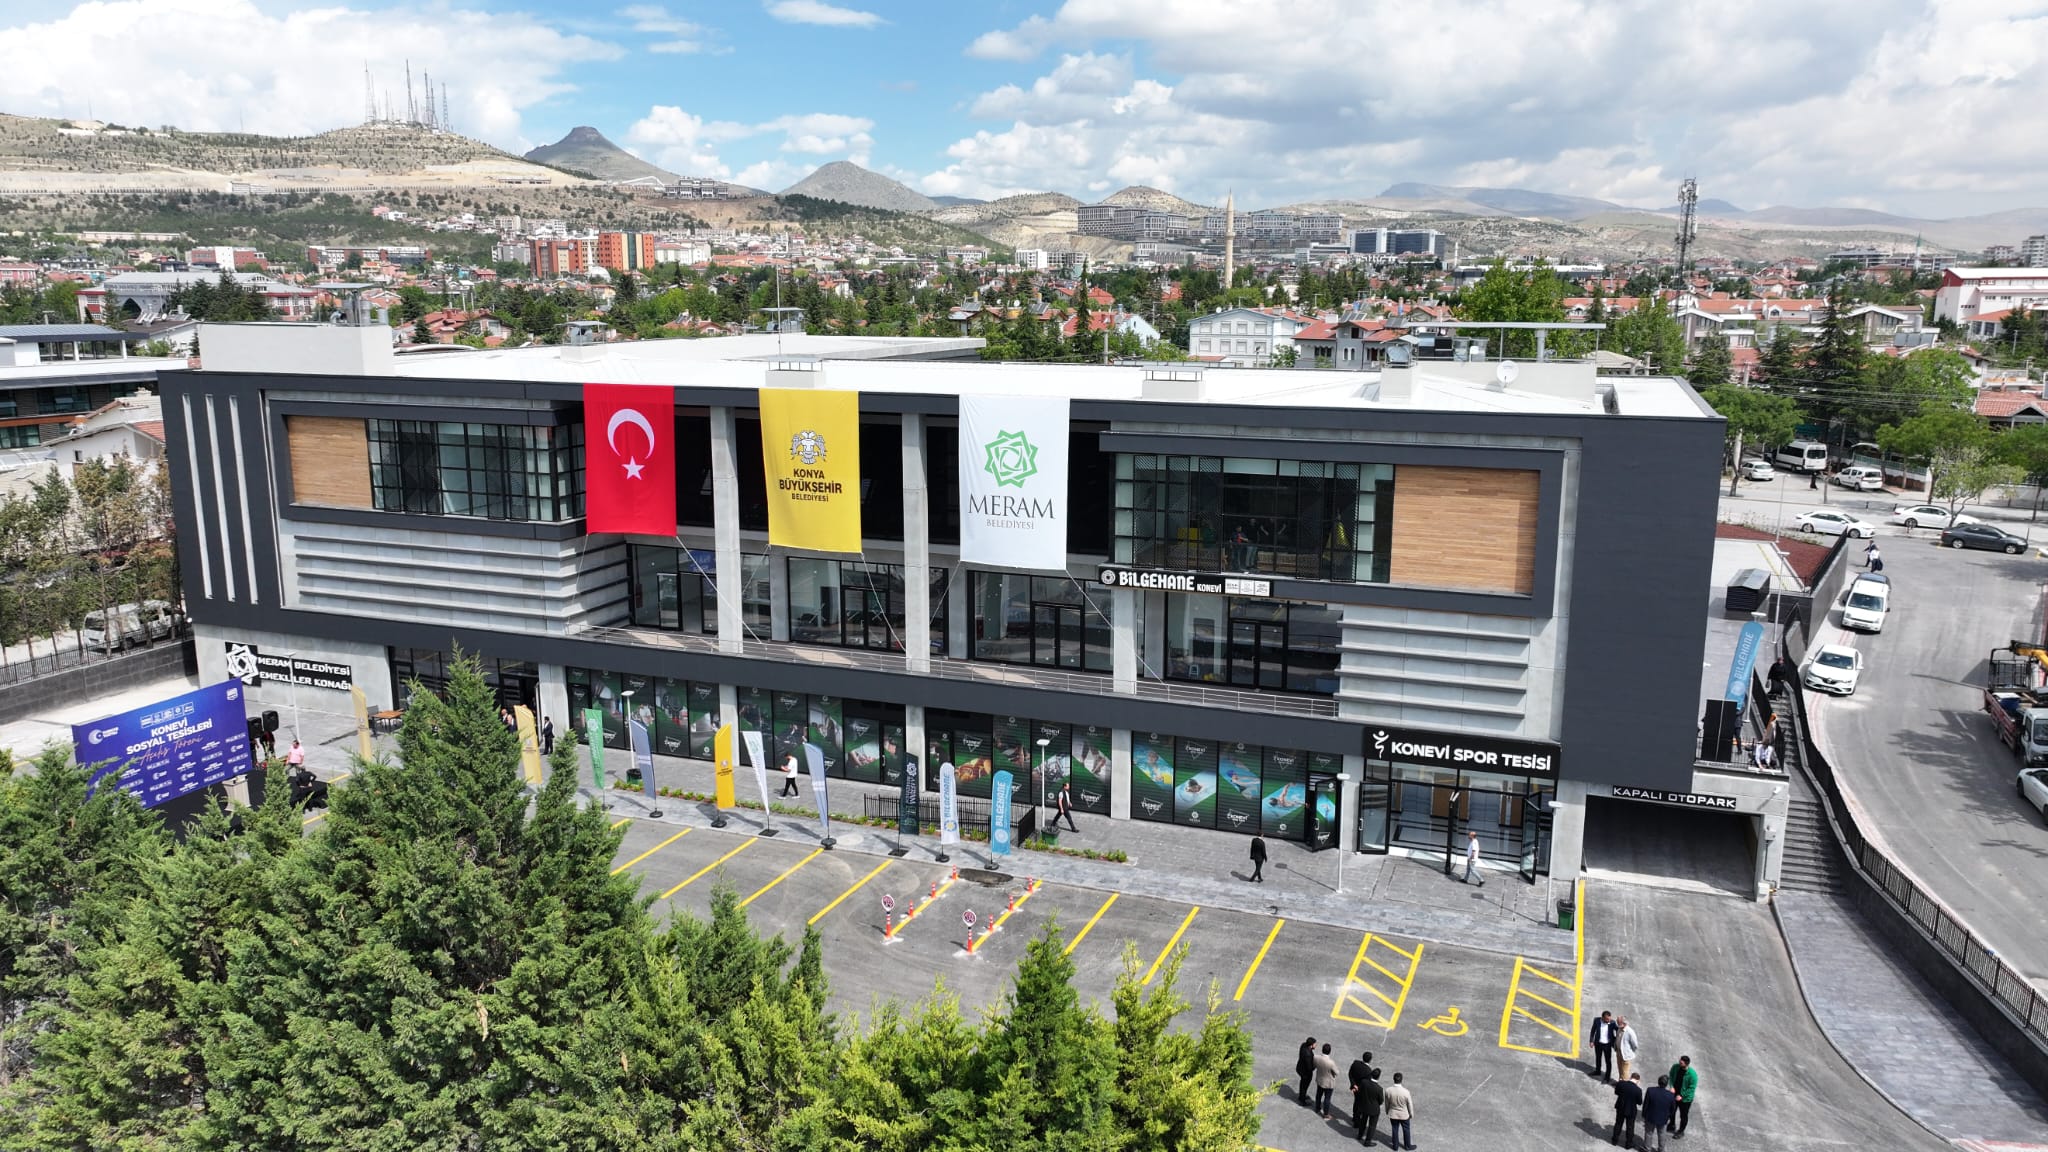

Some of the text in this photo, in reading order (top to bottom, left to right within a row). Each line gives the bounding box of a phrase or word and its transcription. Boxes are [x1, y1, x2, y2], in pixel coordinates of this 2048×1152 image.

[793, 468, 825, 479] KONYA
[791, 493, 829, 502] BELEDİYESİ
[968, 493, 1056, 519] MERAM
[986, 519, 1034, 530] BELEDİYESİ
[258, 656, 350, 676] MERAM BELEDİYESİ
[260, 672, 352, 690] EMEKLLER KONAĞI
[126, 718, 213, 755] SOSYAL TESİSLERİ
[151, 717, 188, 737] KONEVİ
[1391, 741, 1551, 771] KONEVİ SPOR TESİSİ
[1613, 787, 1736, 808] KAPALI OTOPARK
